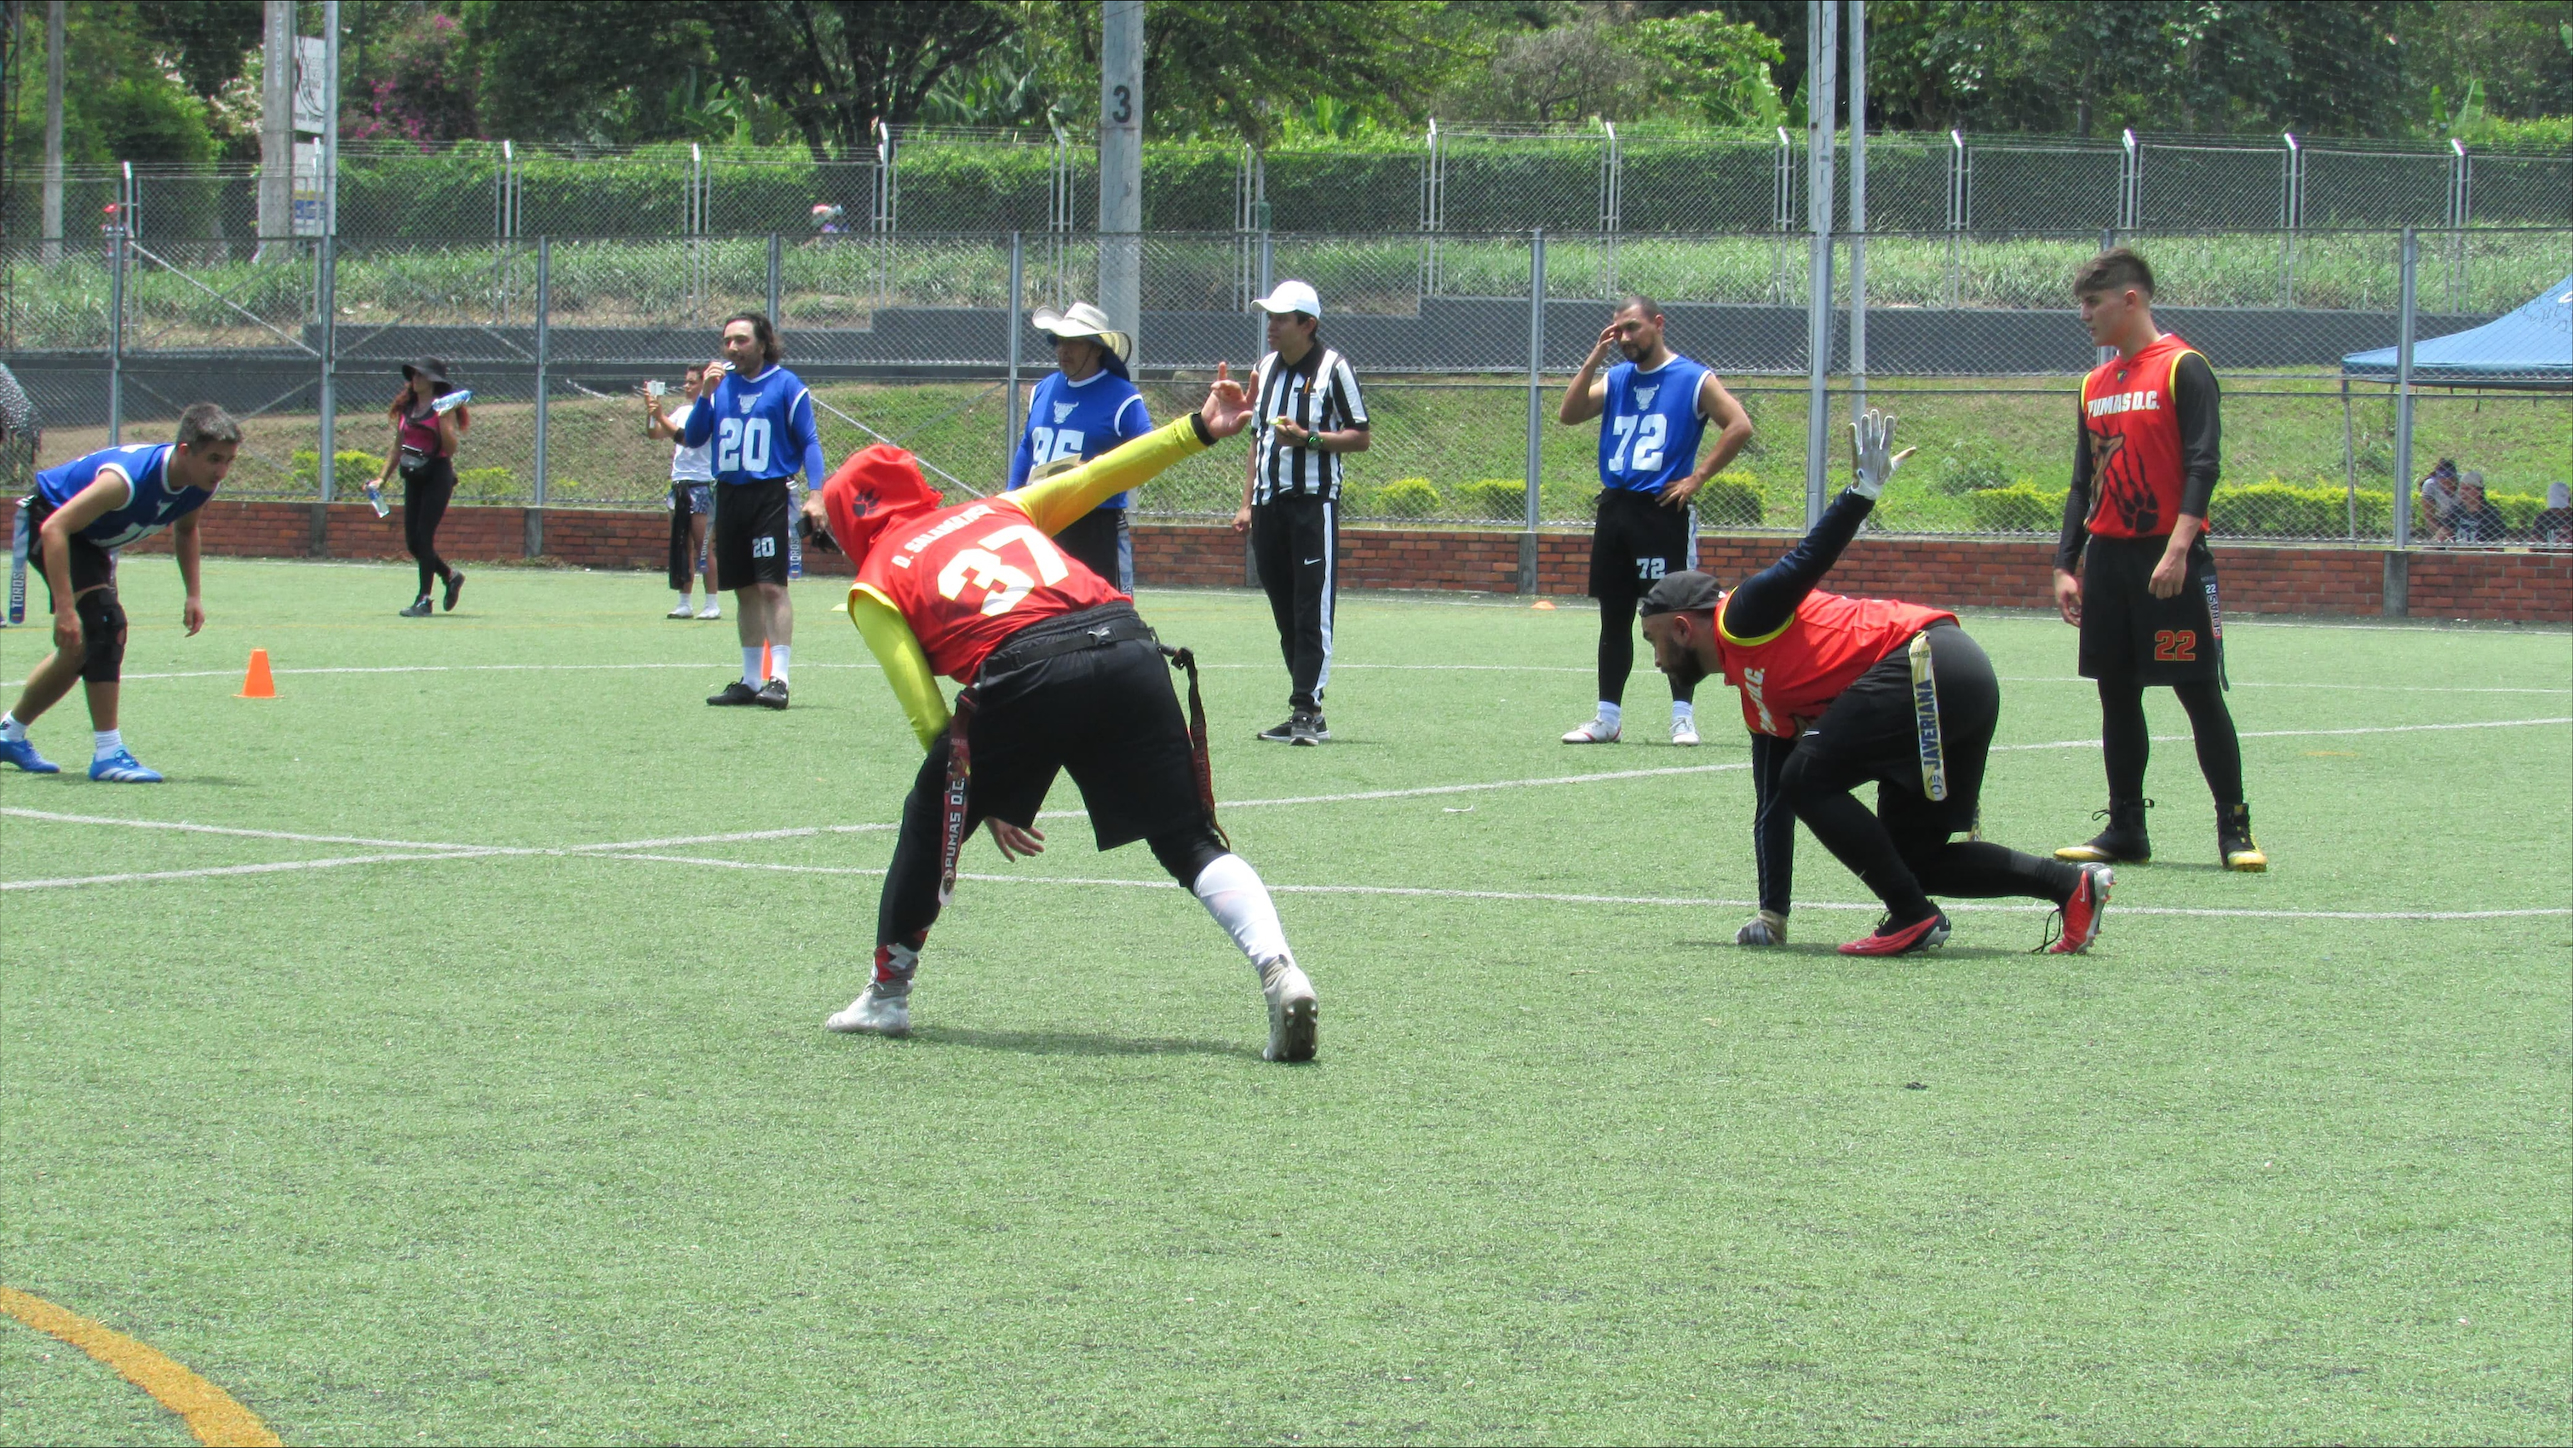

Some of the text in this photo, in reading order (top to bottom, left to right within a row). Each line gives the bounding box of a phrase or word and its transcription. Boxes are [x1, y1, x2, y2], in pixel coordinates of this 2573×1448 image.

[1112, 85, 1132, 123] 3
[2087, 391, 2160, 420] PUMAS D.C.
[718, 417, 771, 472] 20
[1608, 413, 1667, 472] 72
[752, 536, 775, 558] 20
[790, 538, 800, 567] TOROS
[891, 555, 914, 569] D.
[937, 524, 1069, 617] 37
[1636, 557, 1666, 580] 72
[12, 572, 24, 609] TOROS
[2205, 584, 2216, 594] 22
[2155, 630, 2195, 661] 22
[1915, 679, 1942, 770] JAVERIANA
[944, 778, 966, 868] PUMAS D.C.
